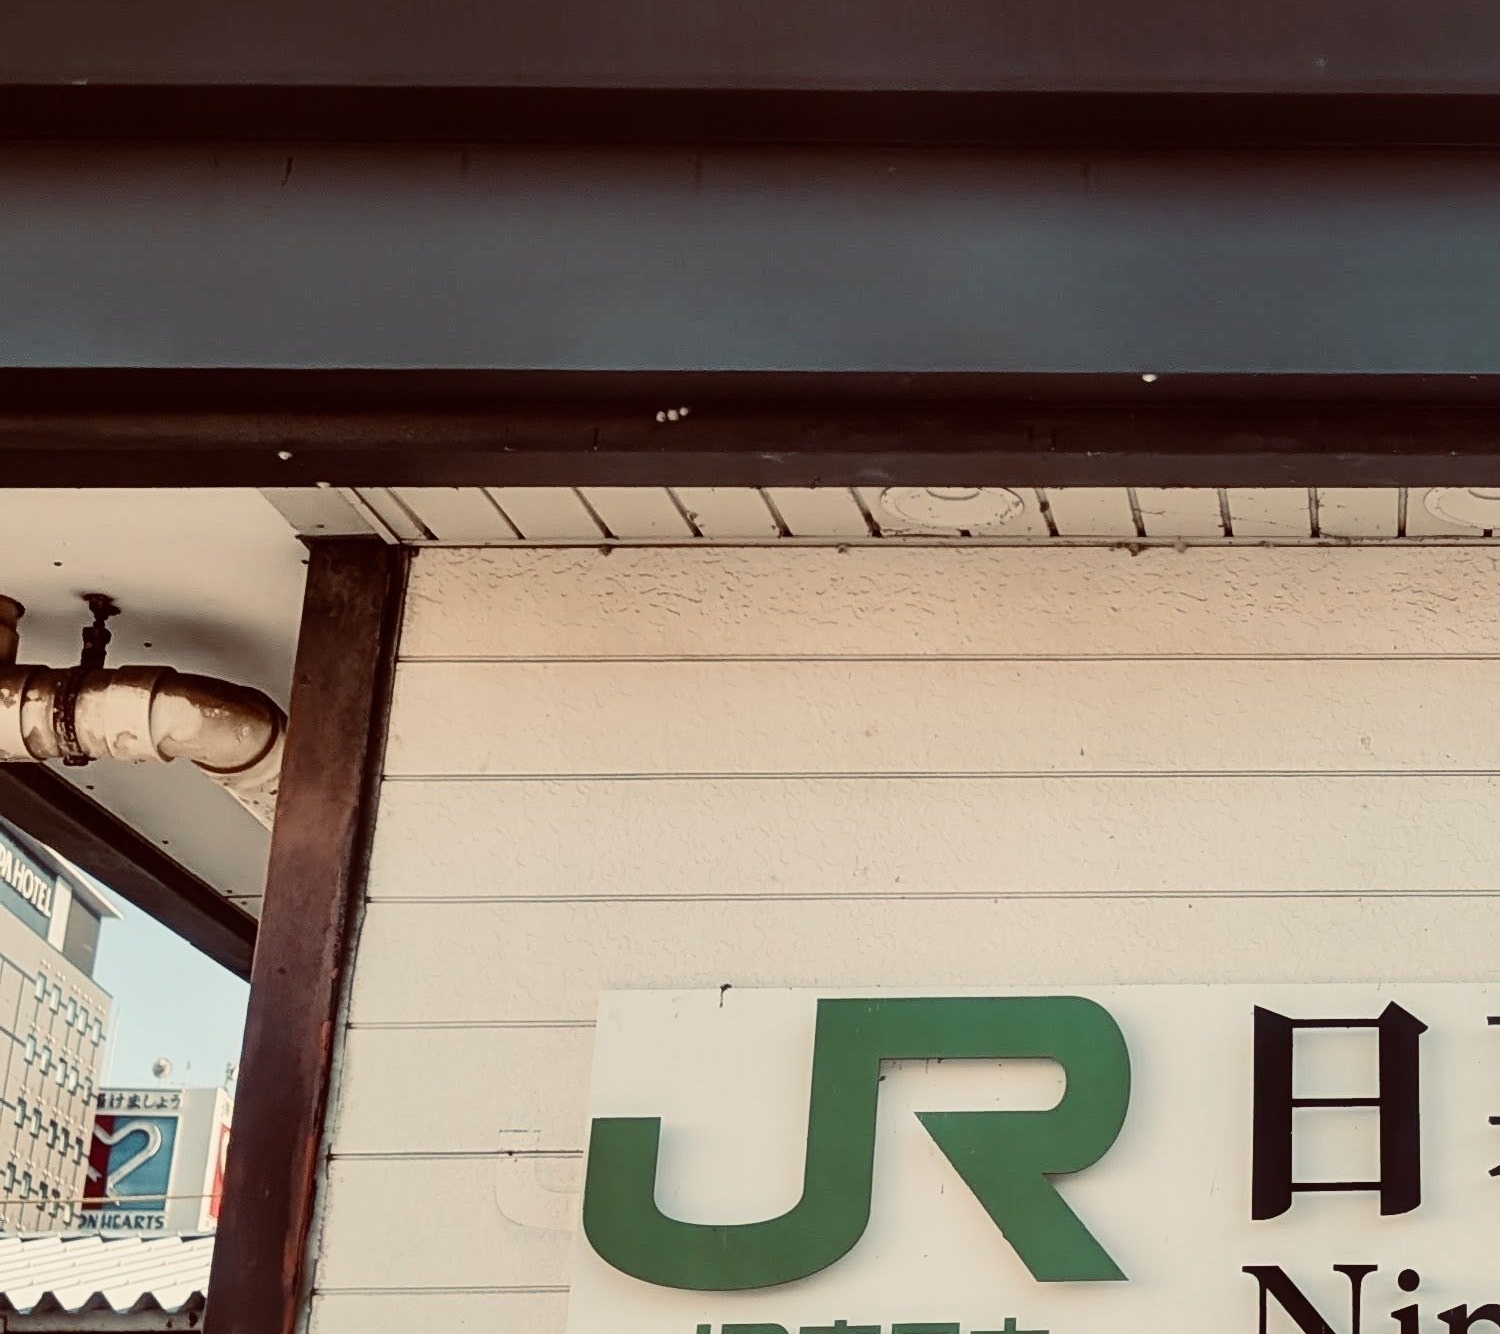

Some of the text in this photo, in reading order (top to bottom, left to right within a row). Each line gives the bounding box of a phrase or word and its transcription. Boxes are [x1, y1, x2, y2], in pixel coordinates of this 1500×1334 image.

[11, 859, 51, 917] HOTEL
[583, 996, 1131, 1295] JR
[101, 1214, 165, 1229] HEARTS
